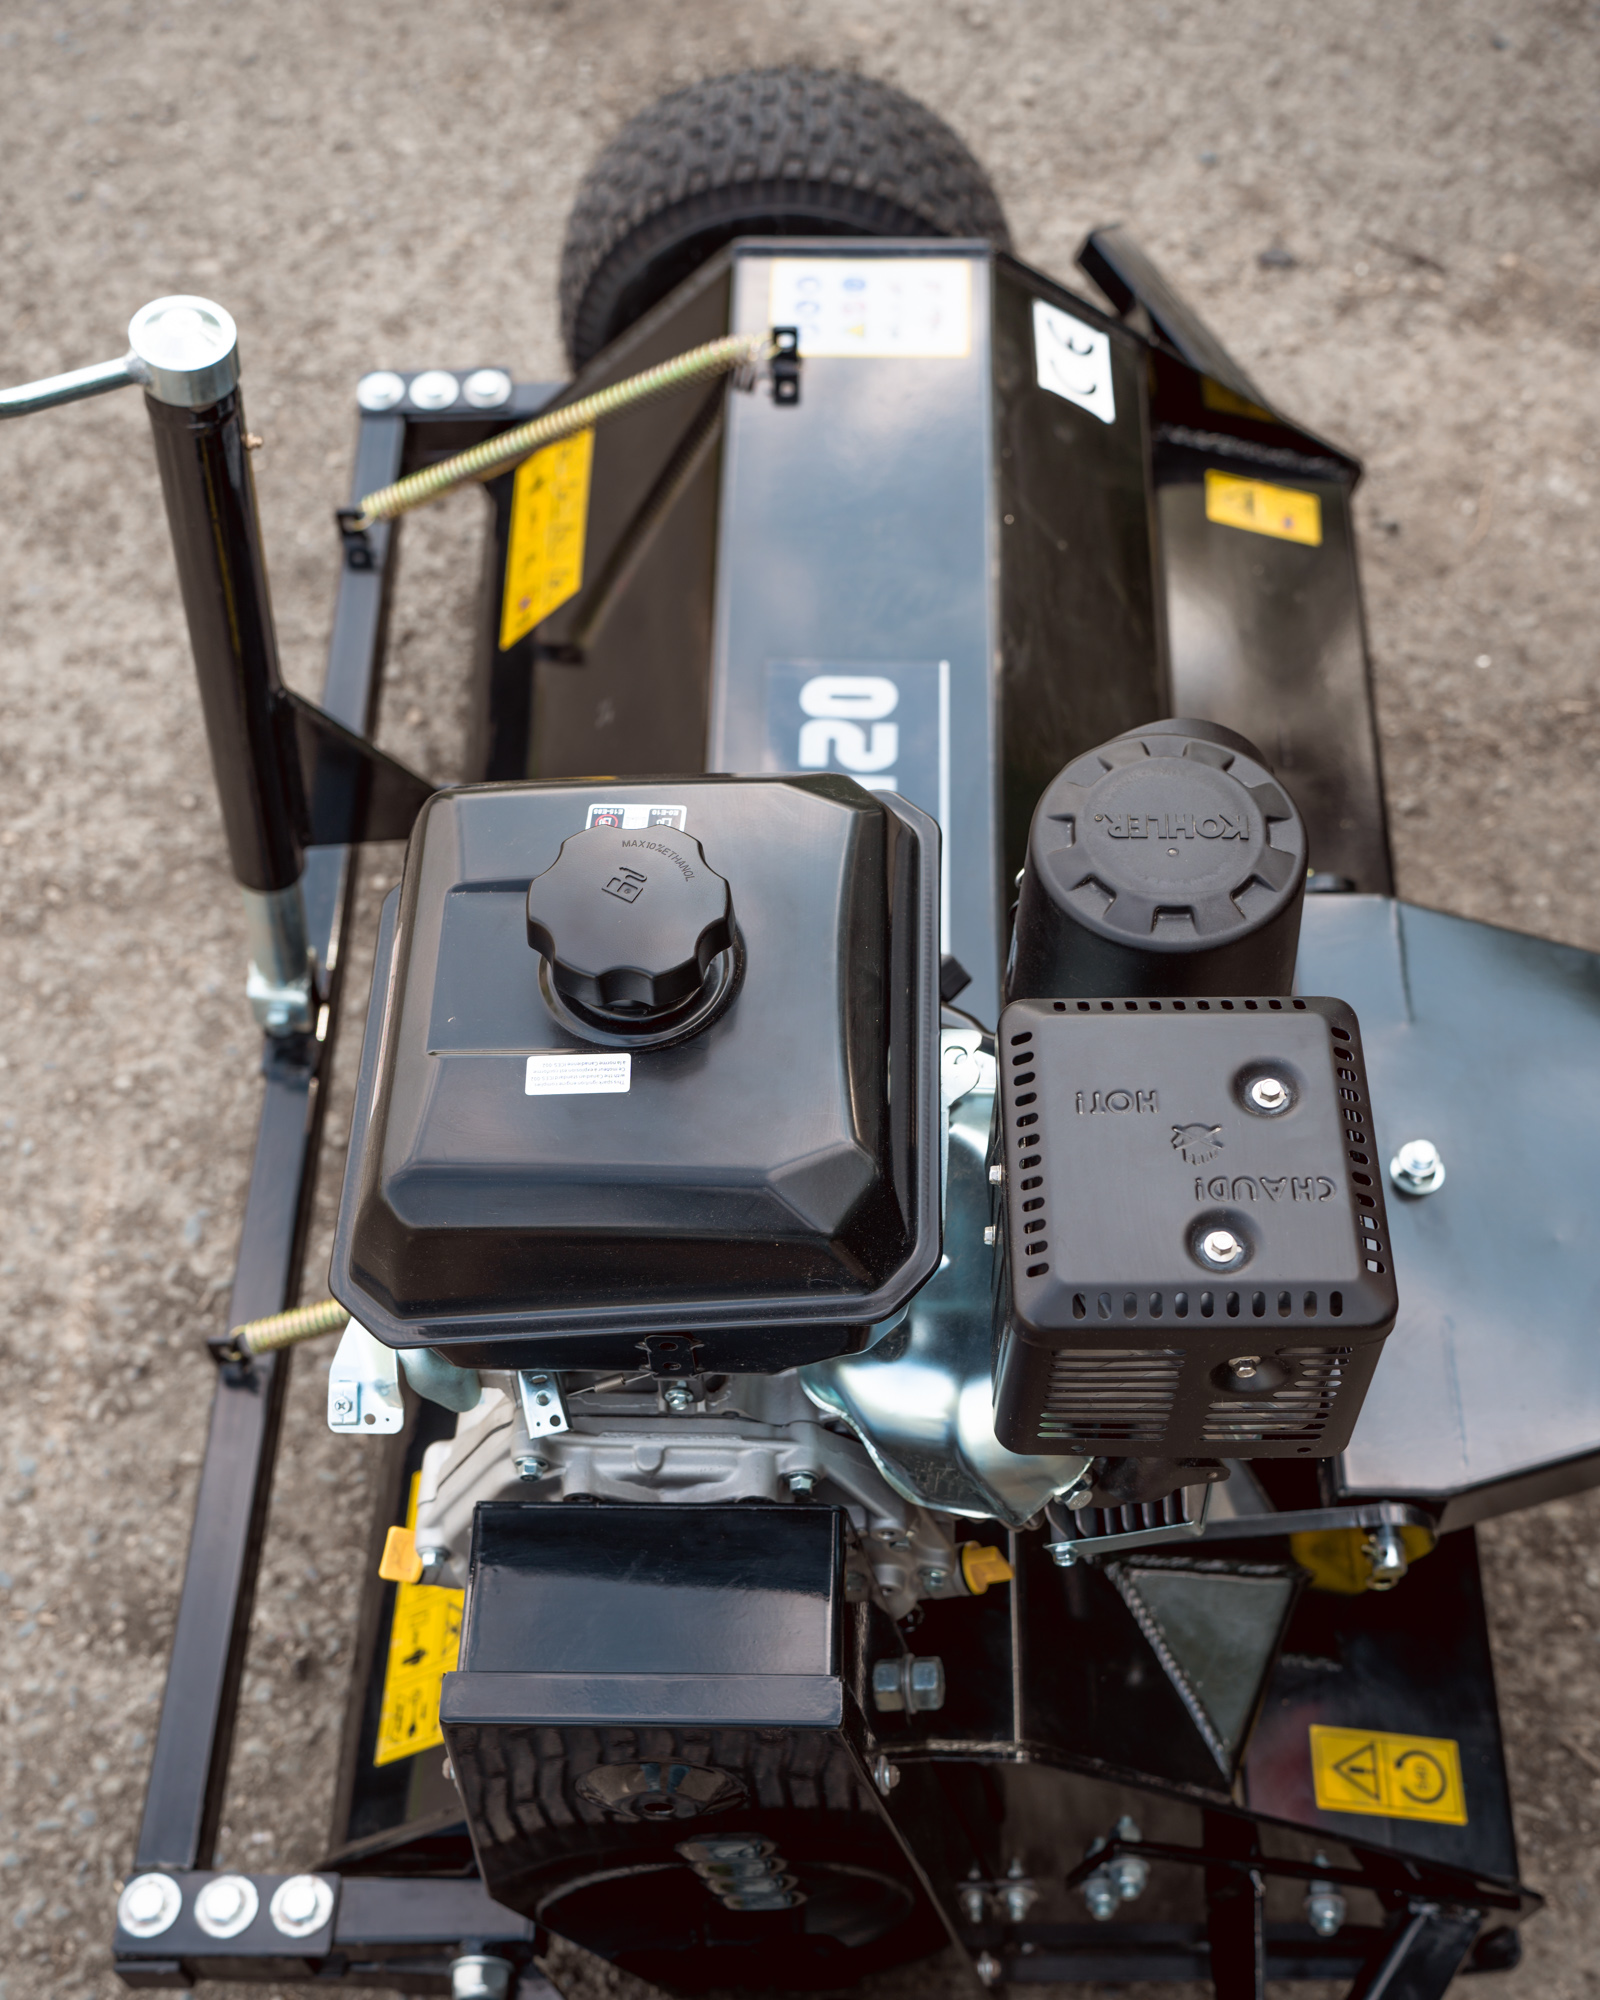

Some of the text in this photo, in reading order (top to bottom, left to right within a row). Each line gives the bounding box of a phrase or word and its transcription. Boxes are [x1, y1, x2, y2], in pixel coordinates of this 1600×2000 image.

[1104, 813, 1250, 841] KOHLER
[1074, 1090, 1159, 1115] HOT!
[1193, 1176, 1337, 1203] CHAUD!
